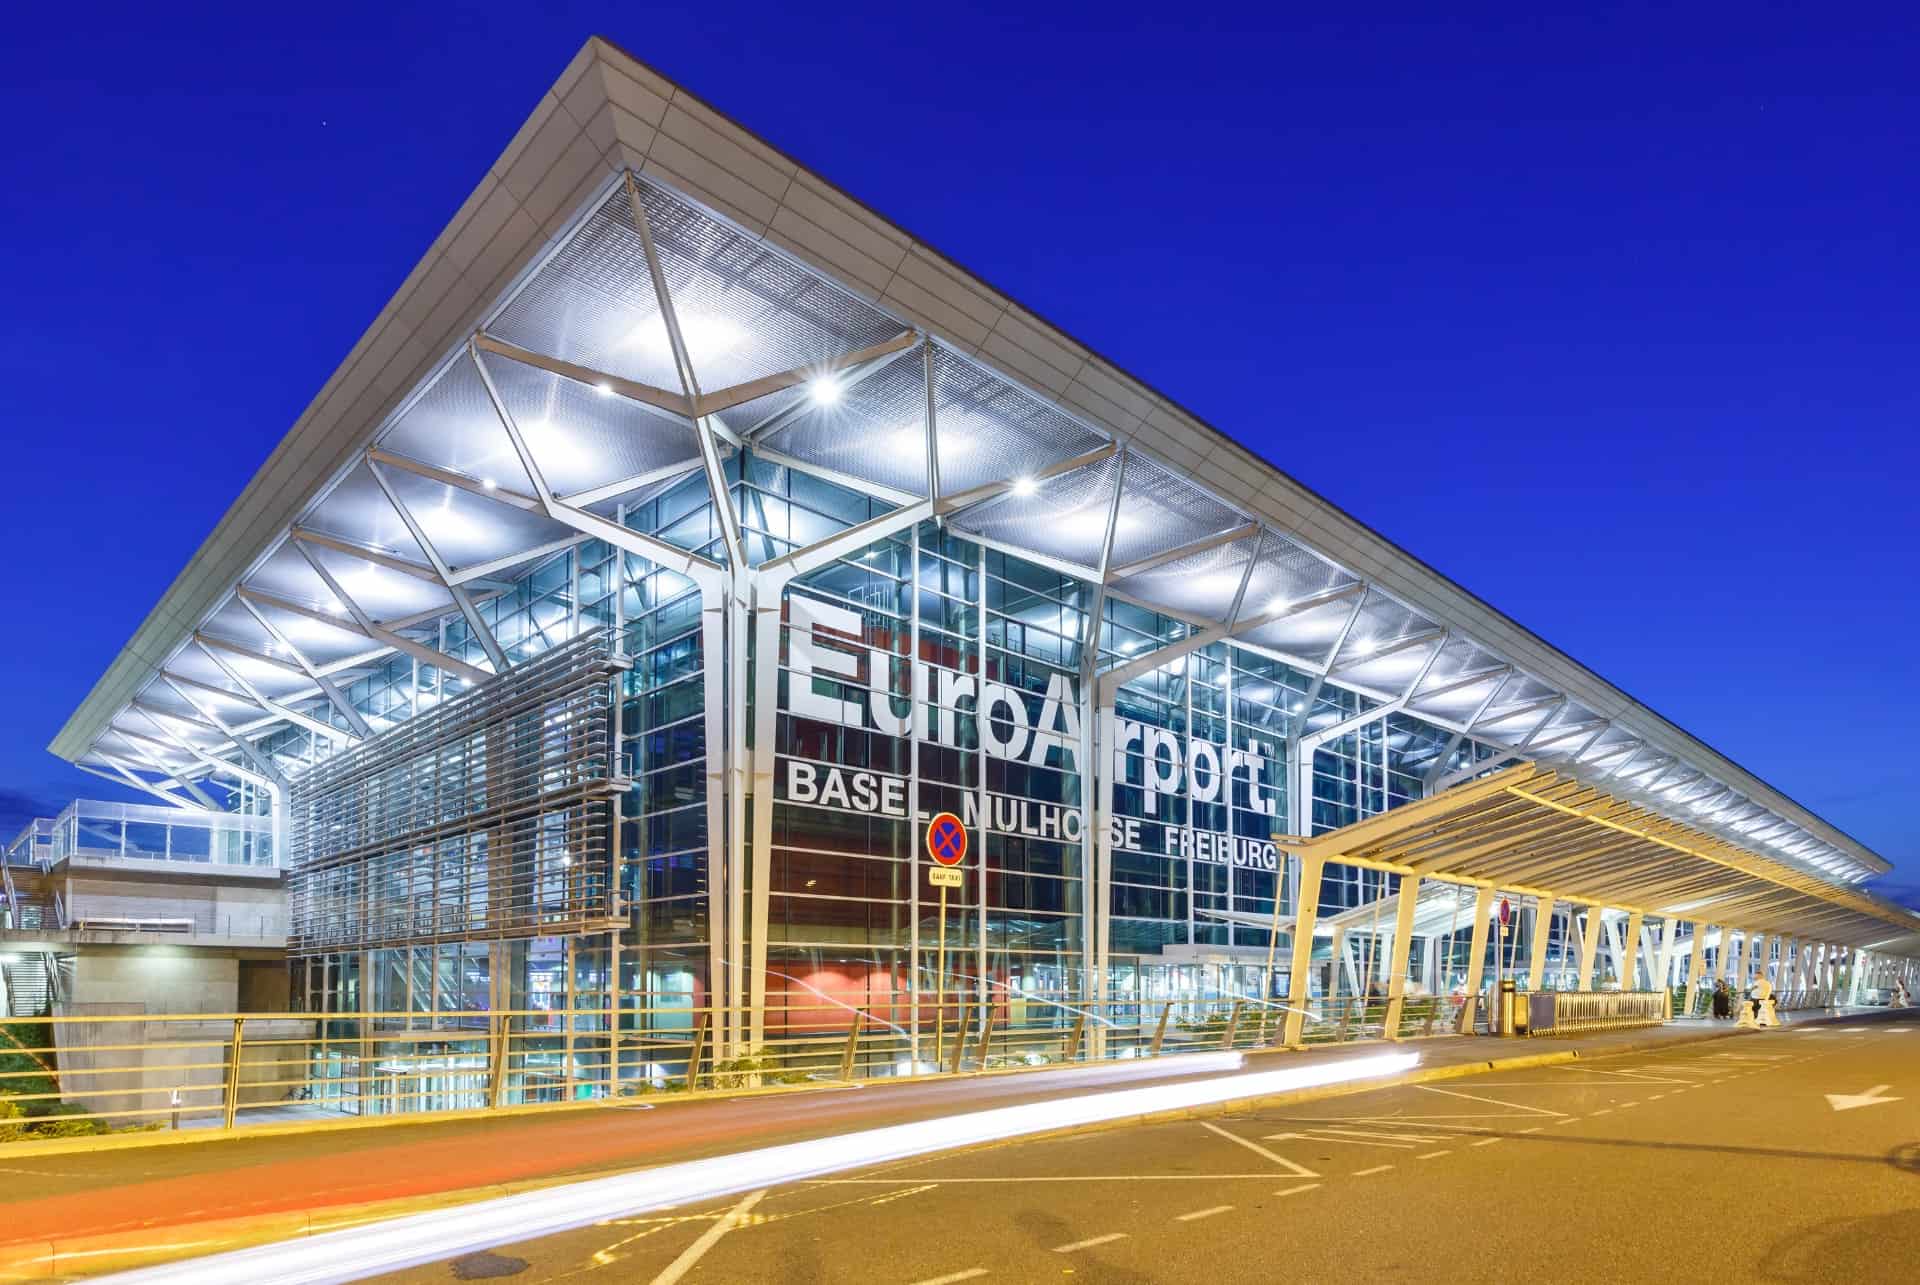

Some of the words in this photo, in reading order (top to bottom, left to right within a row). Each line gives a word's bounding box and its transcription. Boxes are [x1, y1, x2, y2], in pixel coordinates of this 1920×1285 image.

[788, 593, 1276, 816] EuroArport
[787, 761, 930, 819] BASEL
[963, 791, 1142, 850] MULHOSE
